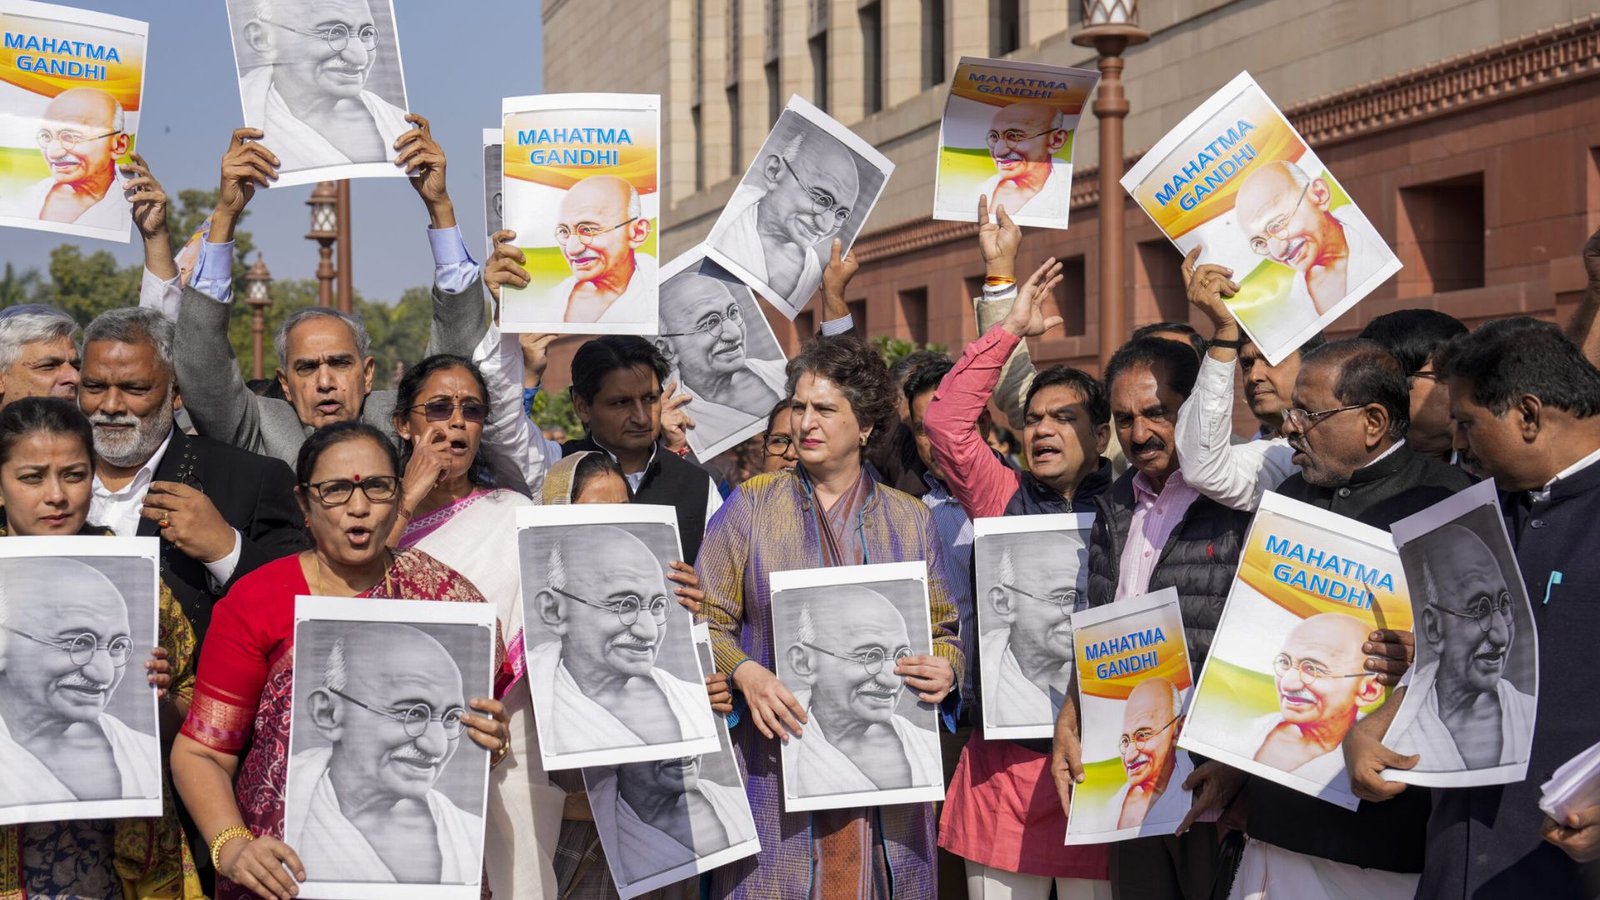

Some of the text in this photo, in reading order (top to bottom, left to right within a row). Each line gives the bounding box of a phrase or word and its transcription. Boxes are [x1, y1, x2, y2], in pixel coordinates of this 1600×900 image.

[4, 32, 121, 63] MAHATMA
[16, 55, 107, 81] GANDHI
[968, 72, 1068, 90] MAHATMA
[976, 84, 1053, 99] GANDHI
[518, 127, 633, 146] MAHATMA
[529, 149, 619, 167] GANDHI
[1154, 119, 1256, 207] MAHATMA
[1178, 143, 1259, 212] GANDHI
[1265, 534, 1395, 593] MAHATMA
[1272, 563, 1373, 611] GANDHI
[1085, 627, 1166, 661] MAHATMA
[1096, 650, 1159, 680] GANDHI
